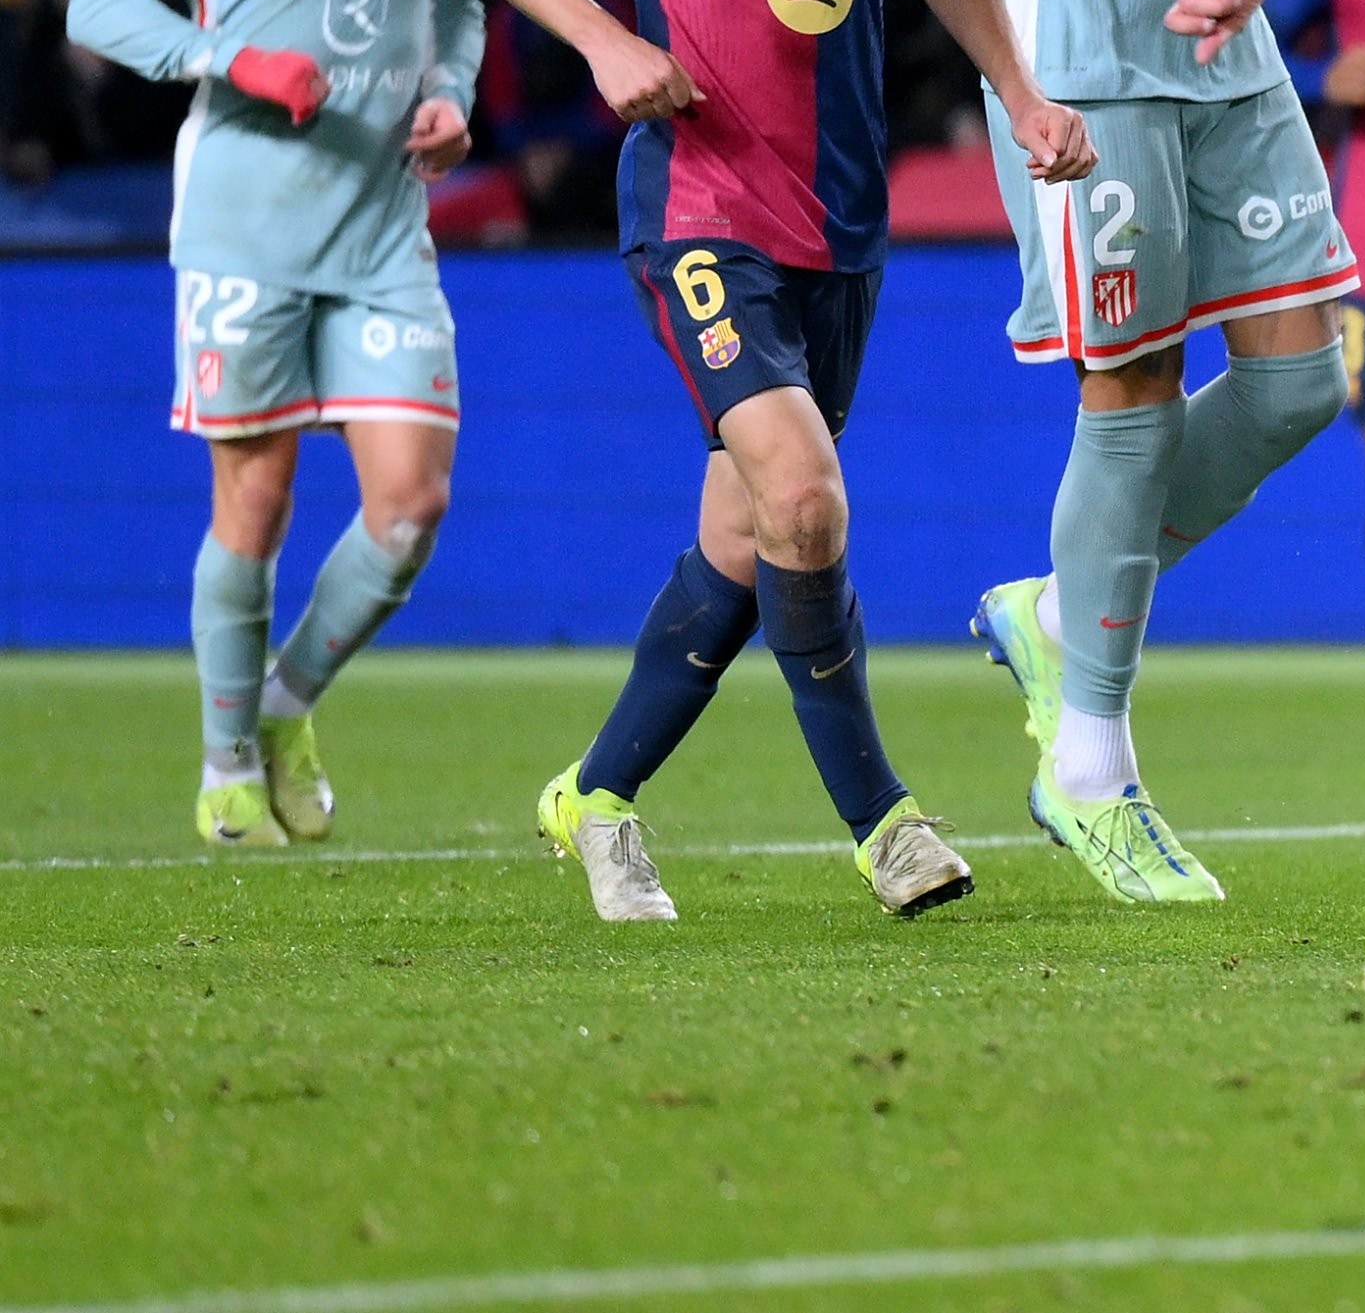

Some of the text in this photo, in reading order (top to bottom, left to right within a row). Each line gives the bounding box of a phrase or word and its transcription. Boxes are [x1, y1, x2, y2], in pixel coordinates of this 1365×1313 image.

[1090, 180, 1136, 266] 2
[185, 269, 258, 345] 22
[673, 249, 726, 322] 6
